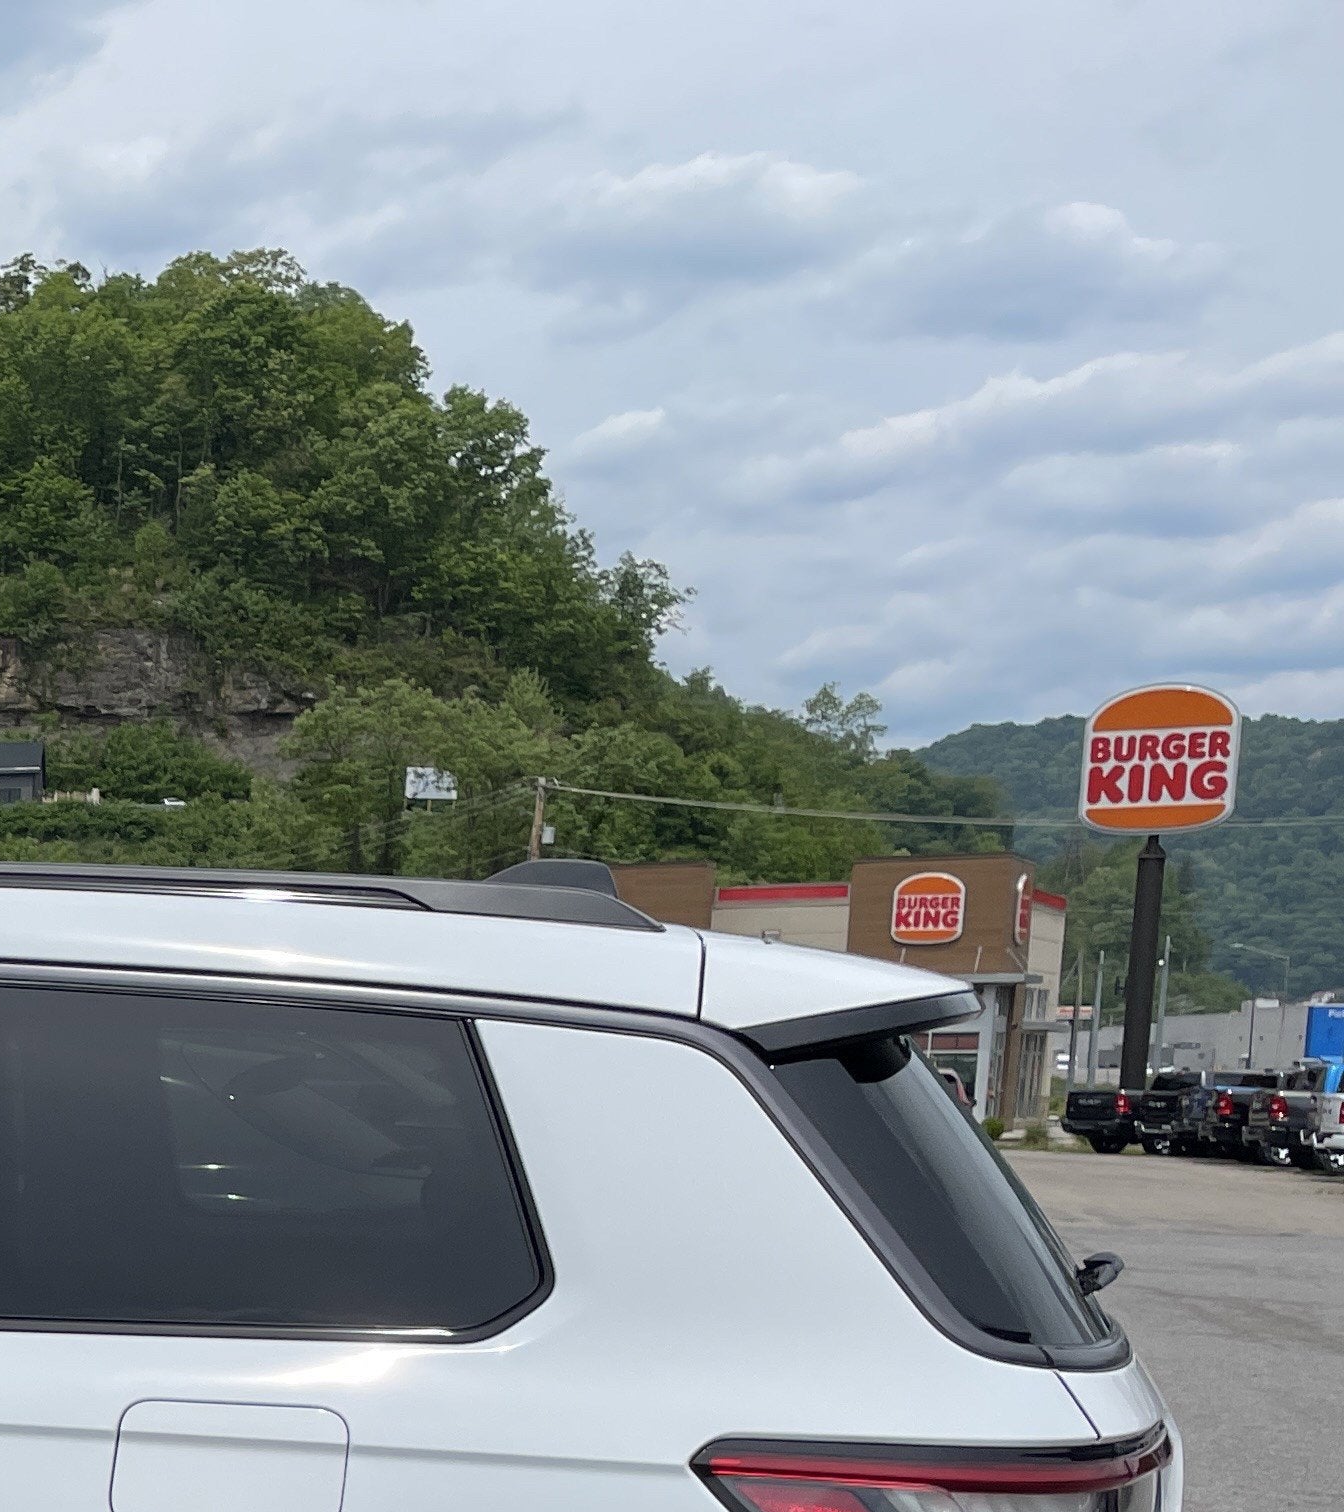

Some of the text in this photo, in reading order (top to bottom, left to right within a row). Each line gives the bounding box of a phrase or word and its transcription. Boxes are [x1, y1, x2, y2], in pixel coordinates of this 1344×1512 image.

[1090, 731, 1231, 764] BURGER
[1087, 760, 1228, 805] KING
[896, 896, 961, 911] BURGER
[895, 909, 959, 929] KING
